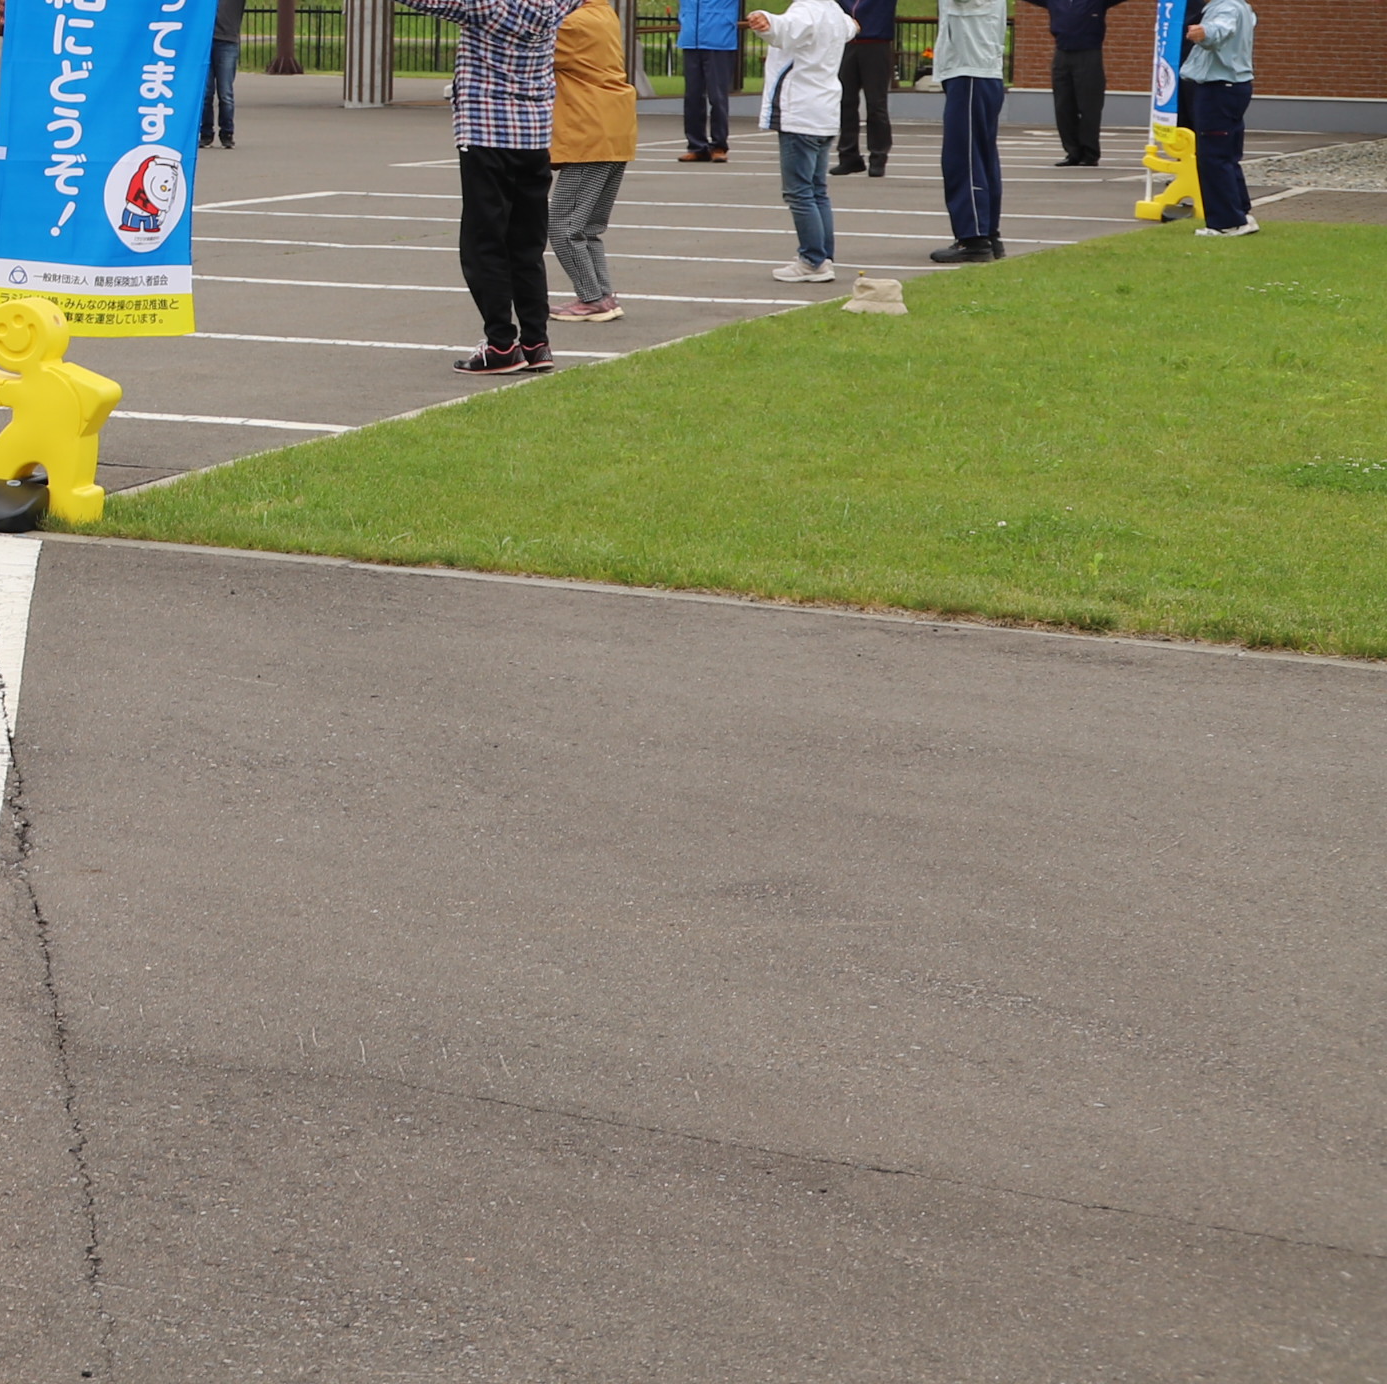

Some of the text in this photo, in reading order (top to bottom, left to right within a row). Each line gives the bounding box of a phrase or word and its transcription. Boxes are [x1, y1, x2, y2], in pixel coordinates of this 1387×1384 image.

[33, 272, 89, 286] 一般財団法人
